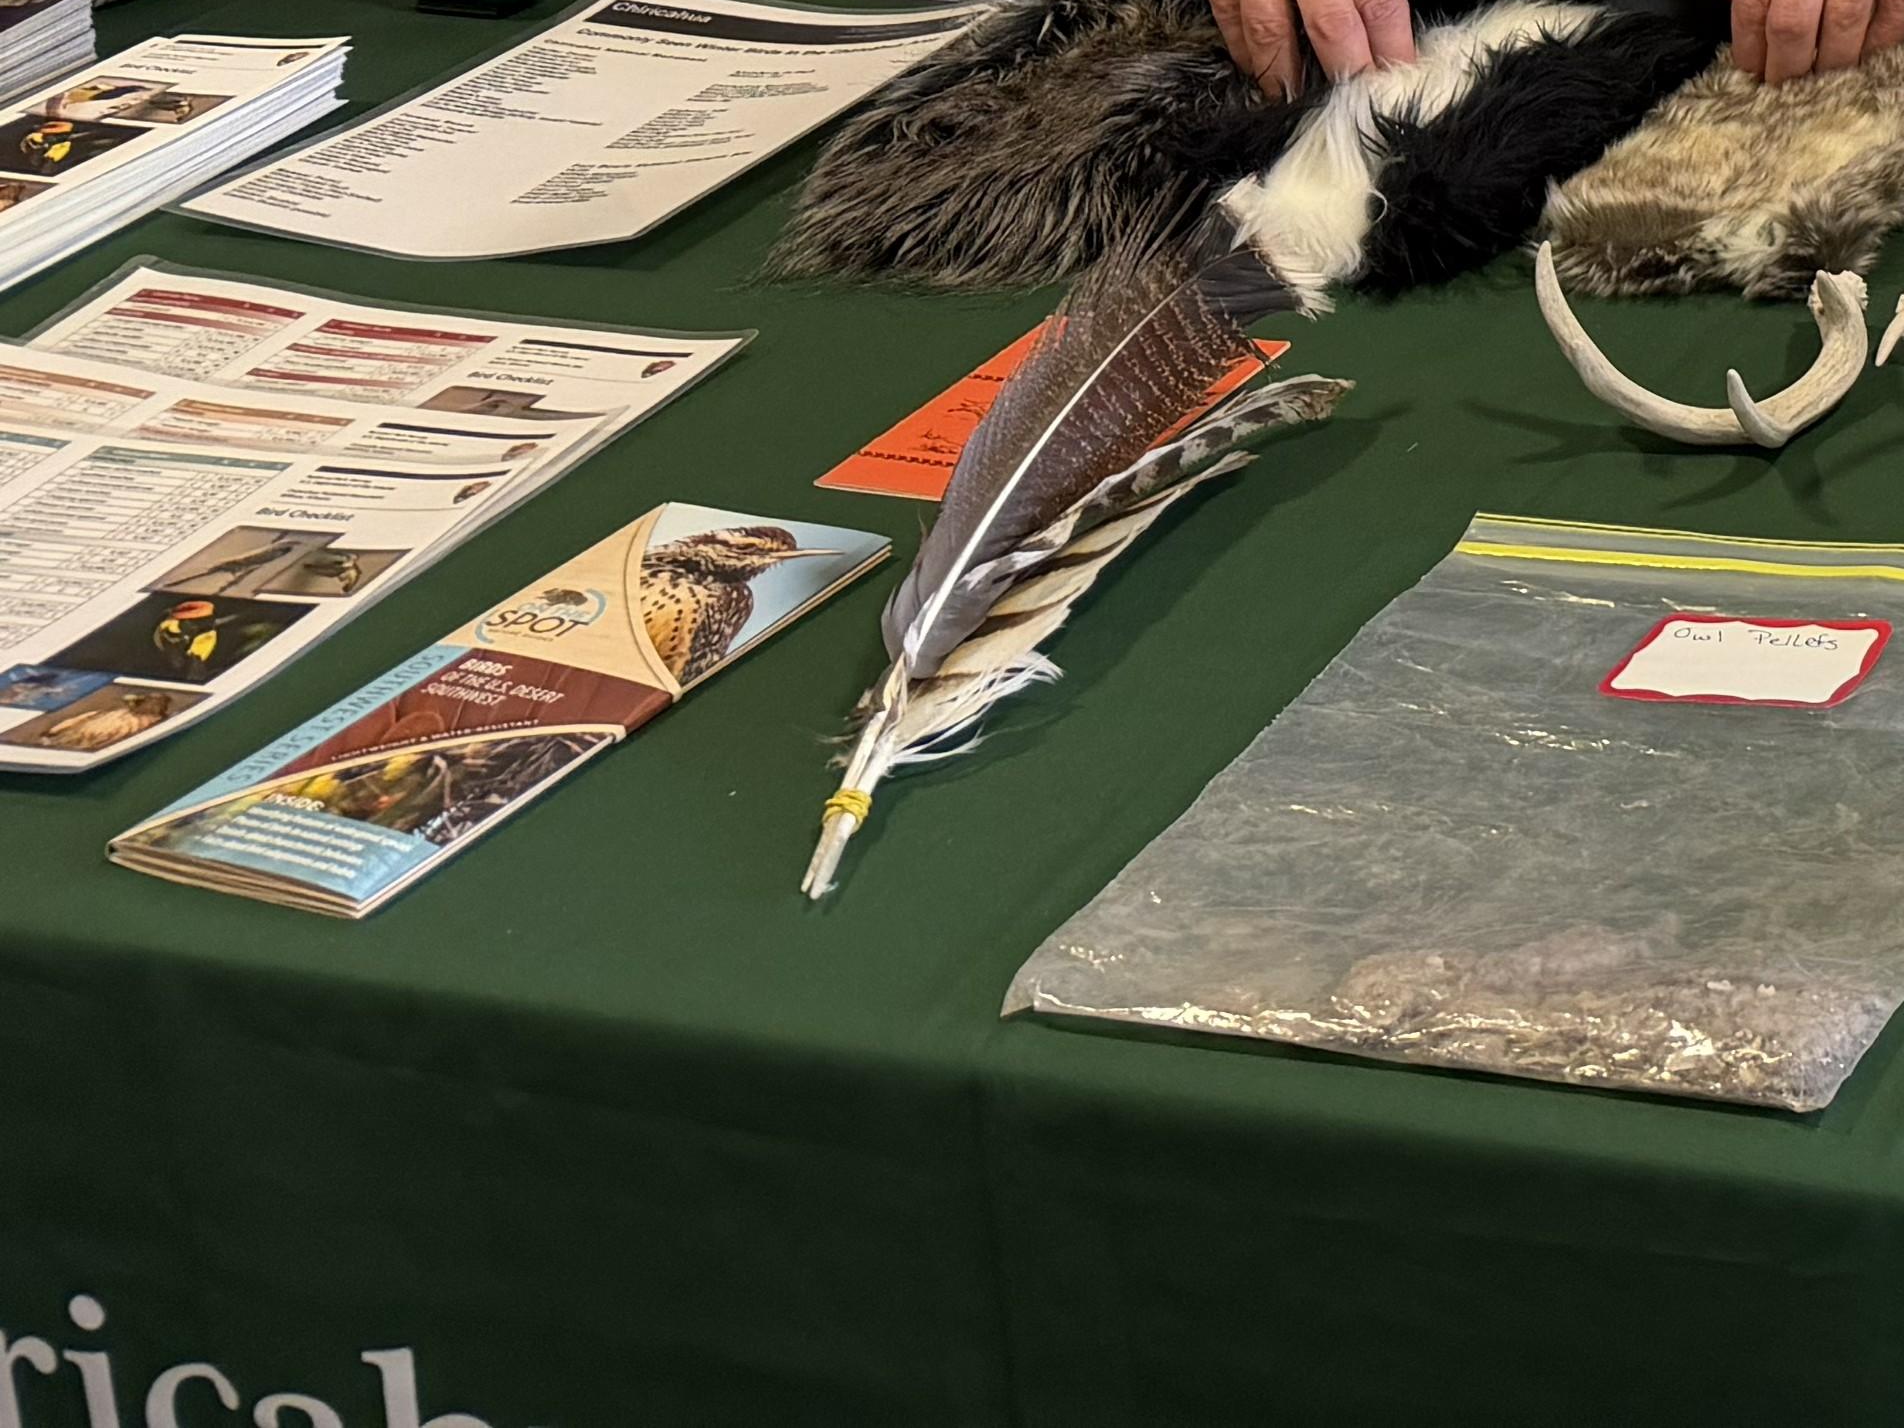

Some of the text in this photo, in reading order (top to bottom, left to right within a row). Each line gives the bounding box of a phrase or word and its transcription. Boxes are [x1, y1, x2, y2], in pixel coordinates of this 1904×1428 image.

[611, 0, 713, 25] Chiricahua
[467, 370, 495, 380] Bird
[256, 506, 355, 522] Bird Checklist
[486, 608, 590, 638] SPOT
[1673, 627, 1839, 651] Owl Pellets
[458, 658, 513, 675] BIRDS
[421, 682, 507, 706] SOUTHWEST
[440, 670, 566, 705] OF THE U.S. DESERT
[226, 651, 446, 784] SOUTHWEST SERIES
